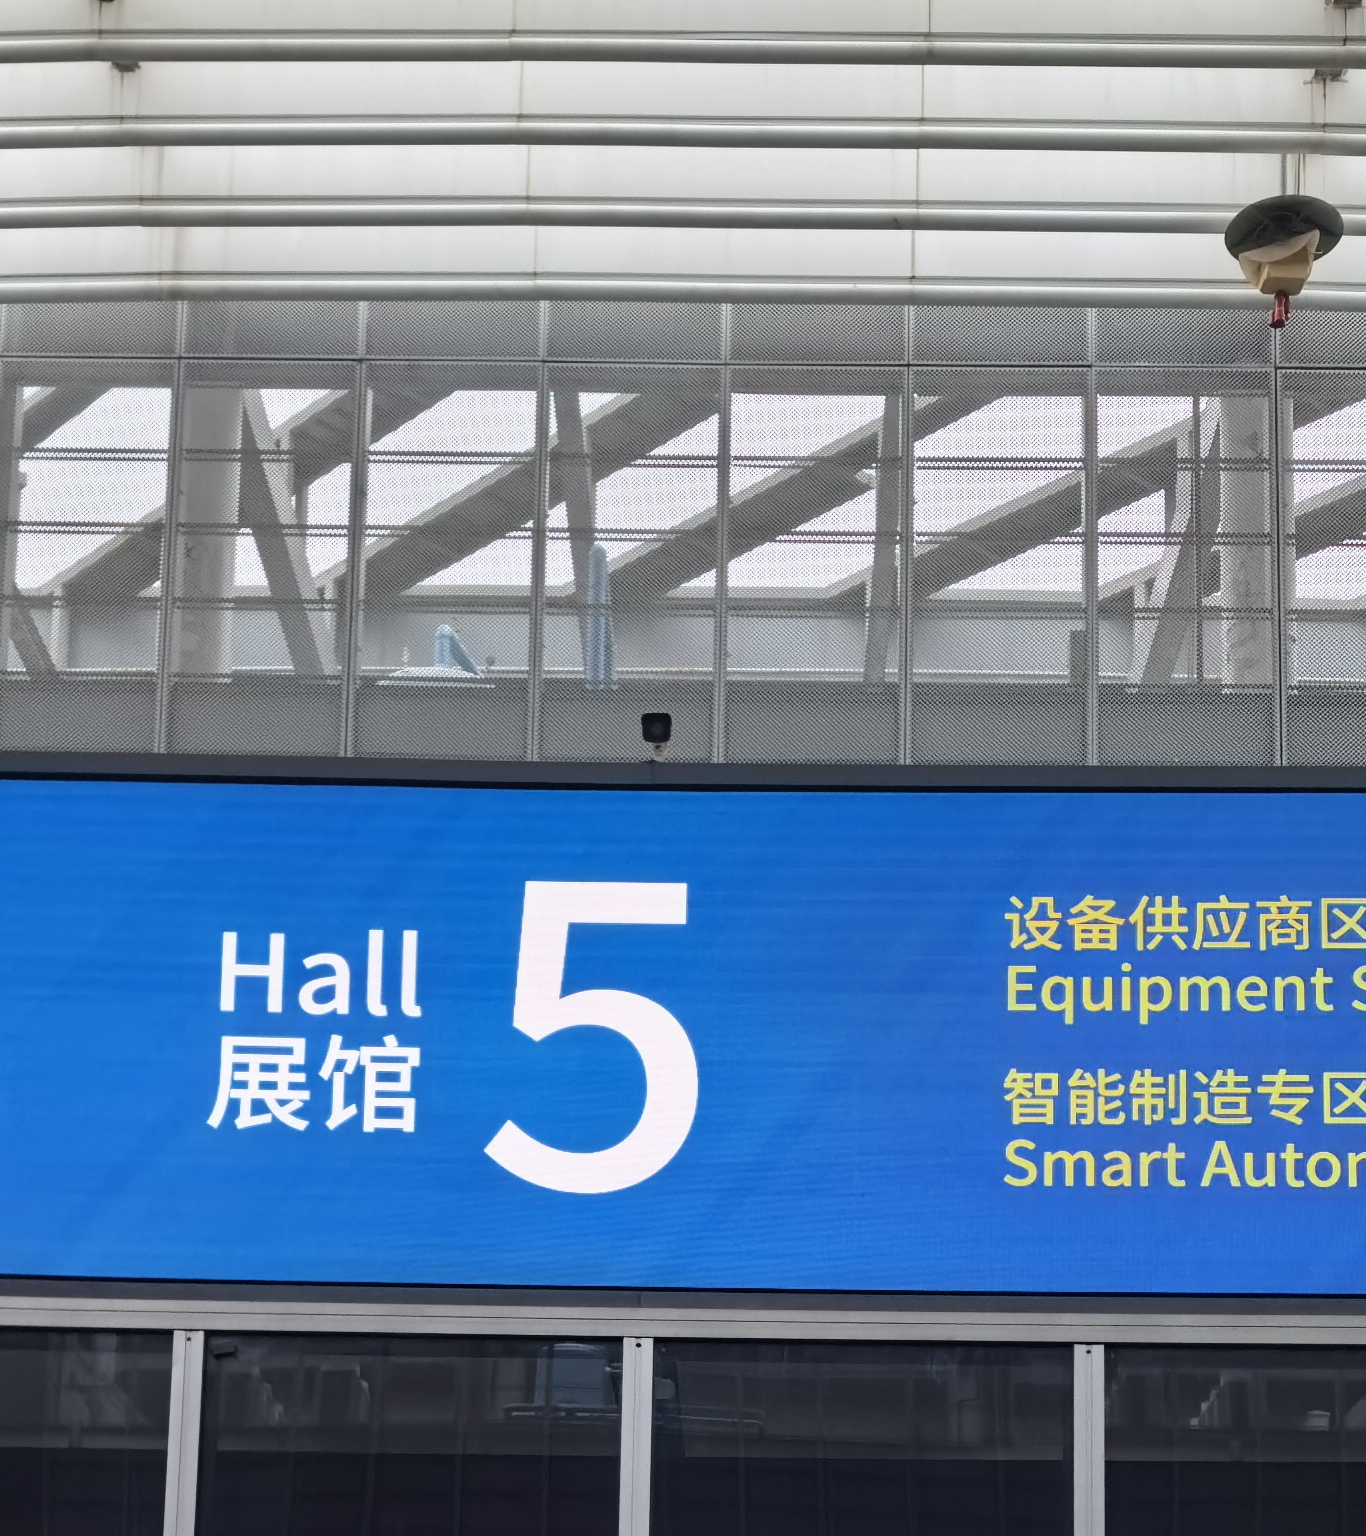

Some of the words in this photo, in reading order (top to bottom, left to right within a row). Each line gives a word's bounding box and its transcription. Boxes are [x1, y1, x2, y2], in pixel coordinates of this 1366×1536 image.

[1006, 962, 1333, 1025] Equipment
[219, 929, 422, 1017] Hall
[484, 880, 698, 1194] 5
[207, 1034, 421, 1133] 展馆
[1004, 1138, 1185, 1187] Smart
